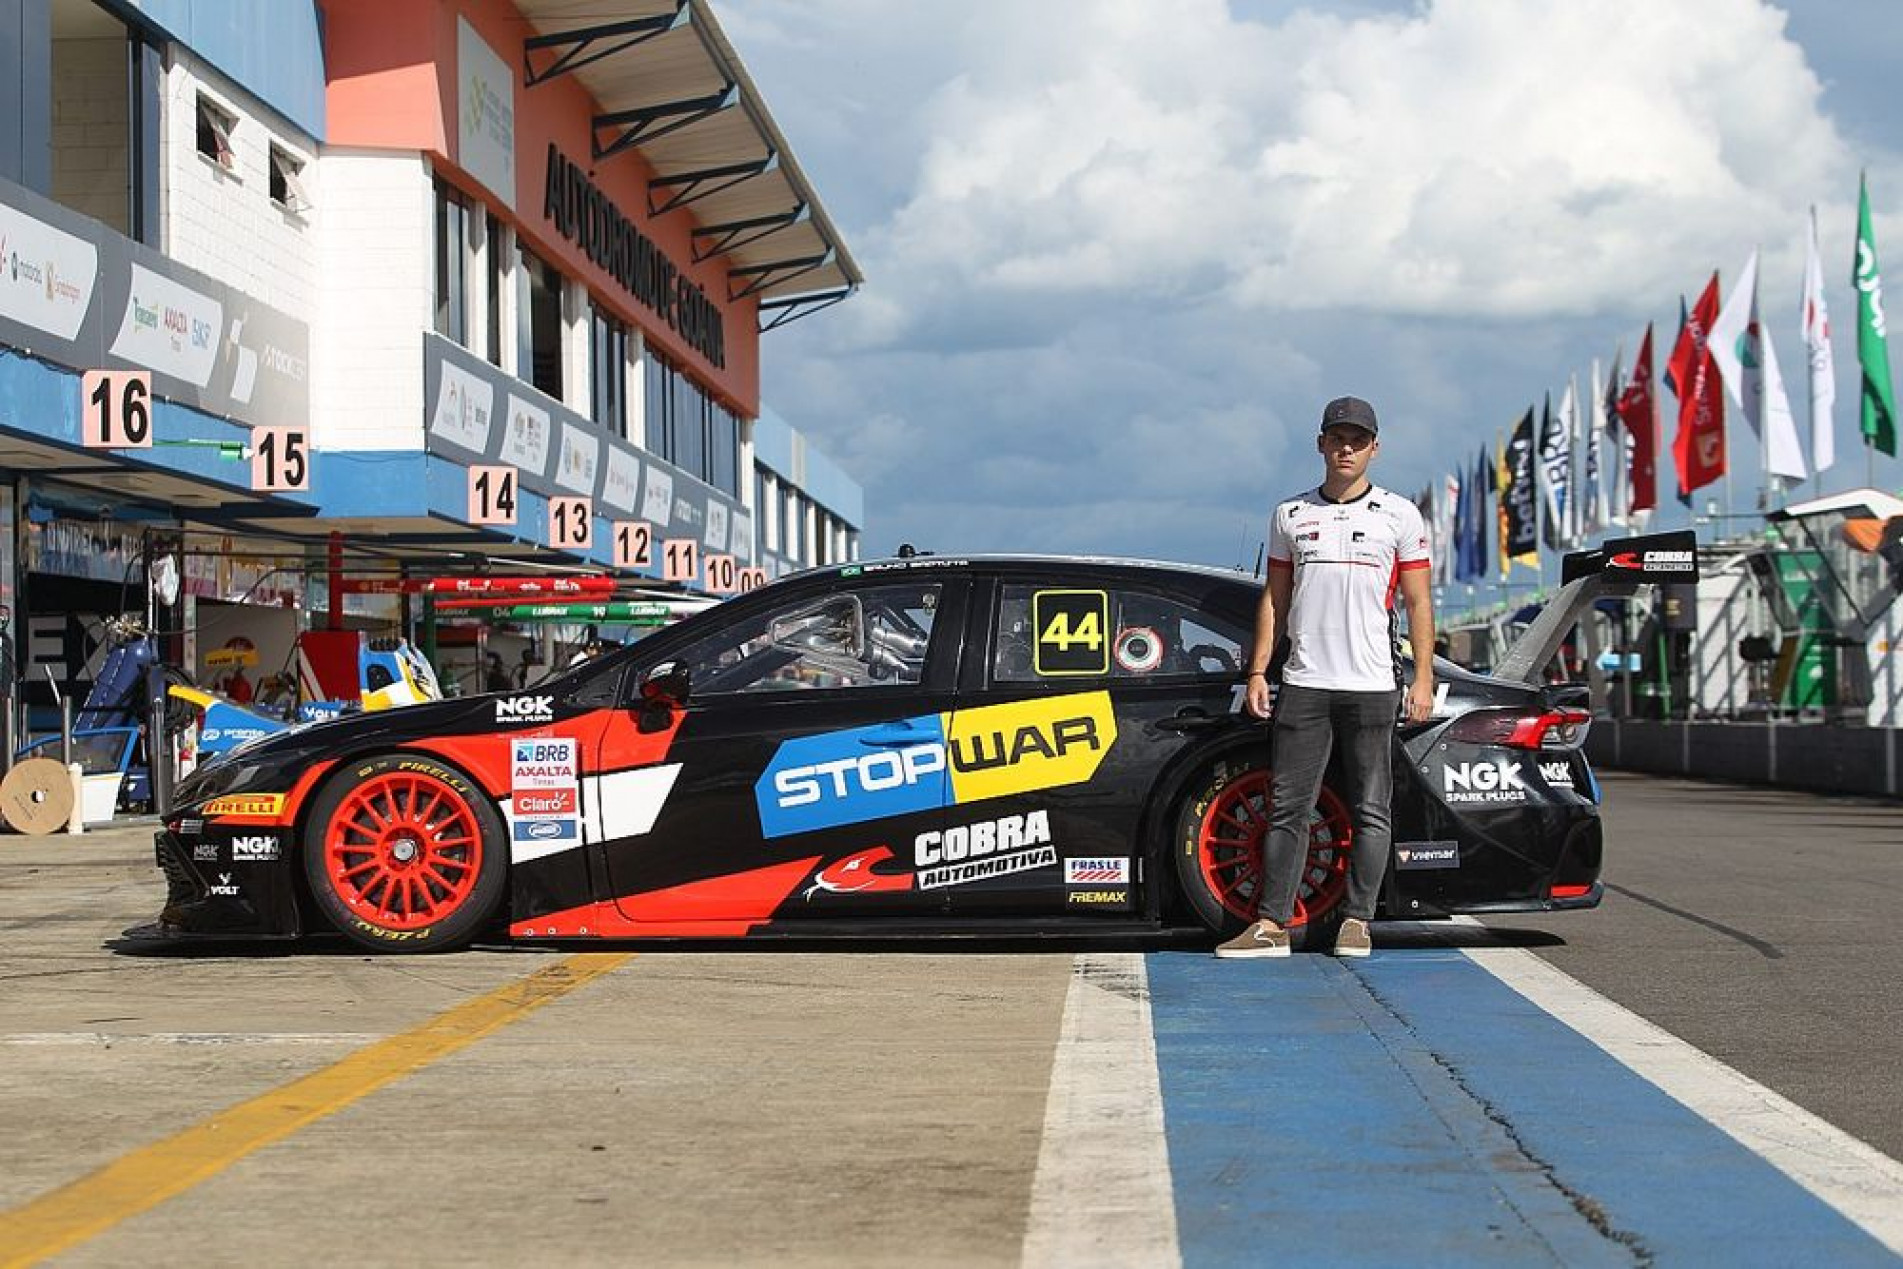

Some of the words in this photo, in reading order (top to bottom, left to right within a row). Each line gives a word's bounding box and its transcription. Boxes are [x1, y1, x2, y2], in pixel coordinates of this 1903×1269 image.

[91, 377, 148, 444] 16
[258, 432, 305, 486] 15
[475, 471, 515, 519] 14
[553, 502, 588, 544] 13
[617, 526, 649, 564] 12
[667, 544, 694, 577] 11
[708, 559, 732, 588] 10
[1040, 611, 1102, 652] 44
[496, 695, 554, 716] NGK
[535, 745, 569, 761] BRB
[775, 743, 946, 808] STOP
[950, 716, 1100, 773] WAR
[516, 766, 573, 777] AXALTA
[1443, 762, 1525, 792] NGK
[1537, 762, 1572, 781] NGK
[520, 796, 562, 812] Claro
[1446, 791, 1485, 802] SPARK
[1486, 791, 1526, 801] PLUGS
[232, 836, 279, 853] NGK
[914, 808, 1051, 867] COBRA
[922, 850, 1054, 888] AUTOMOTIVA
[210, 886, 240, 895] VOLT
[1069, 891, 1127, 903] FREMAX
